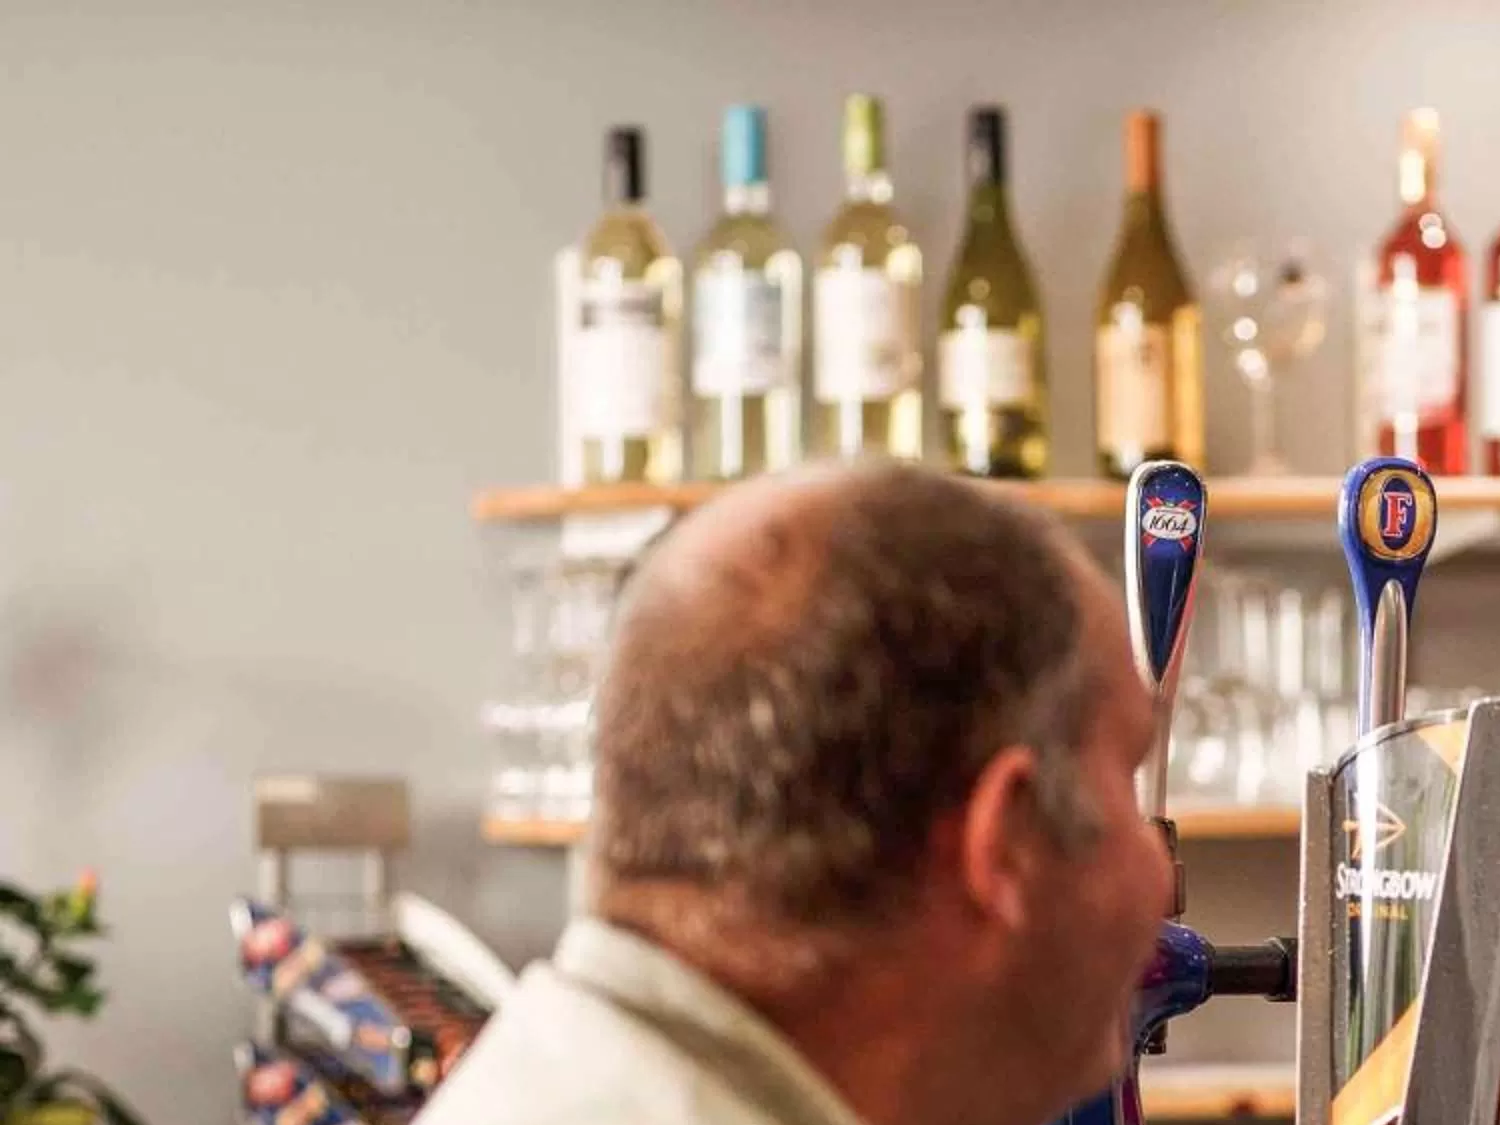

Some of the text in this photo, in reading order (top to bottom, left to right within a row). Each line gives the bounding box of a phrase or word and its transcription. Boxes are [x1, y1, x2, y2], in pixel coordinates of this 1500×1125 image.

[1383, 491, 1412, 537] F
[1149, 515, 1189, 533] 1664
[1346, 902, 1409, 920] ORINAL
